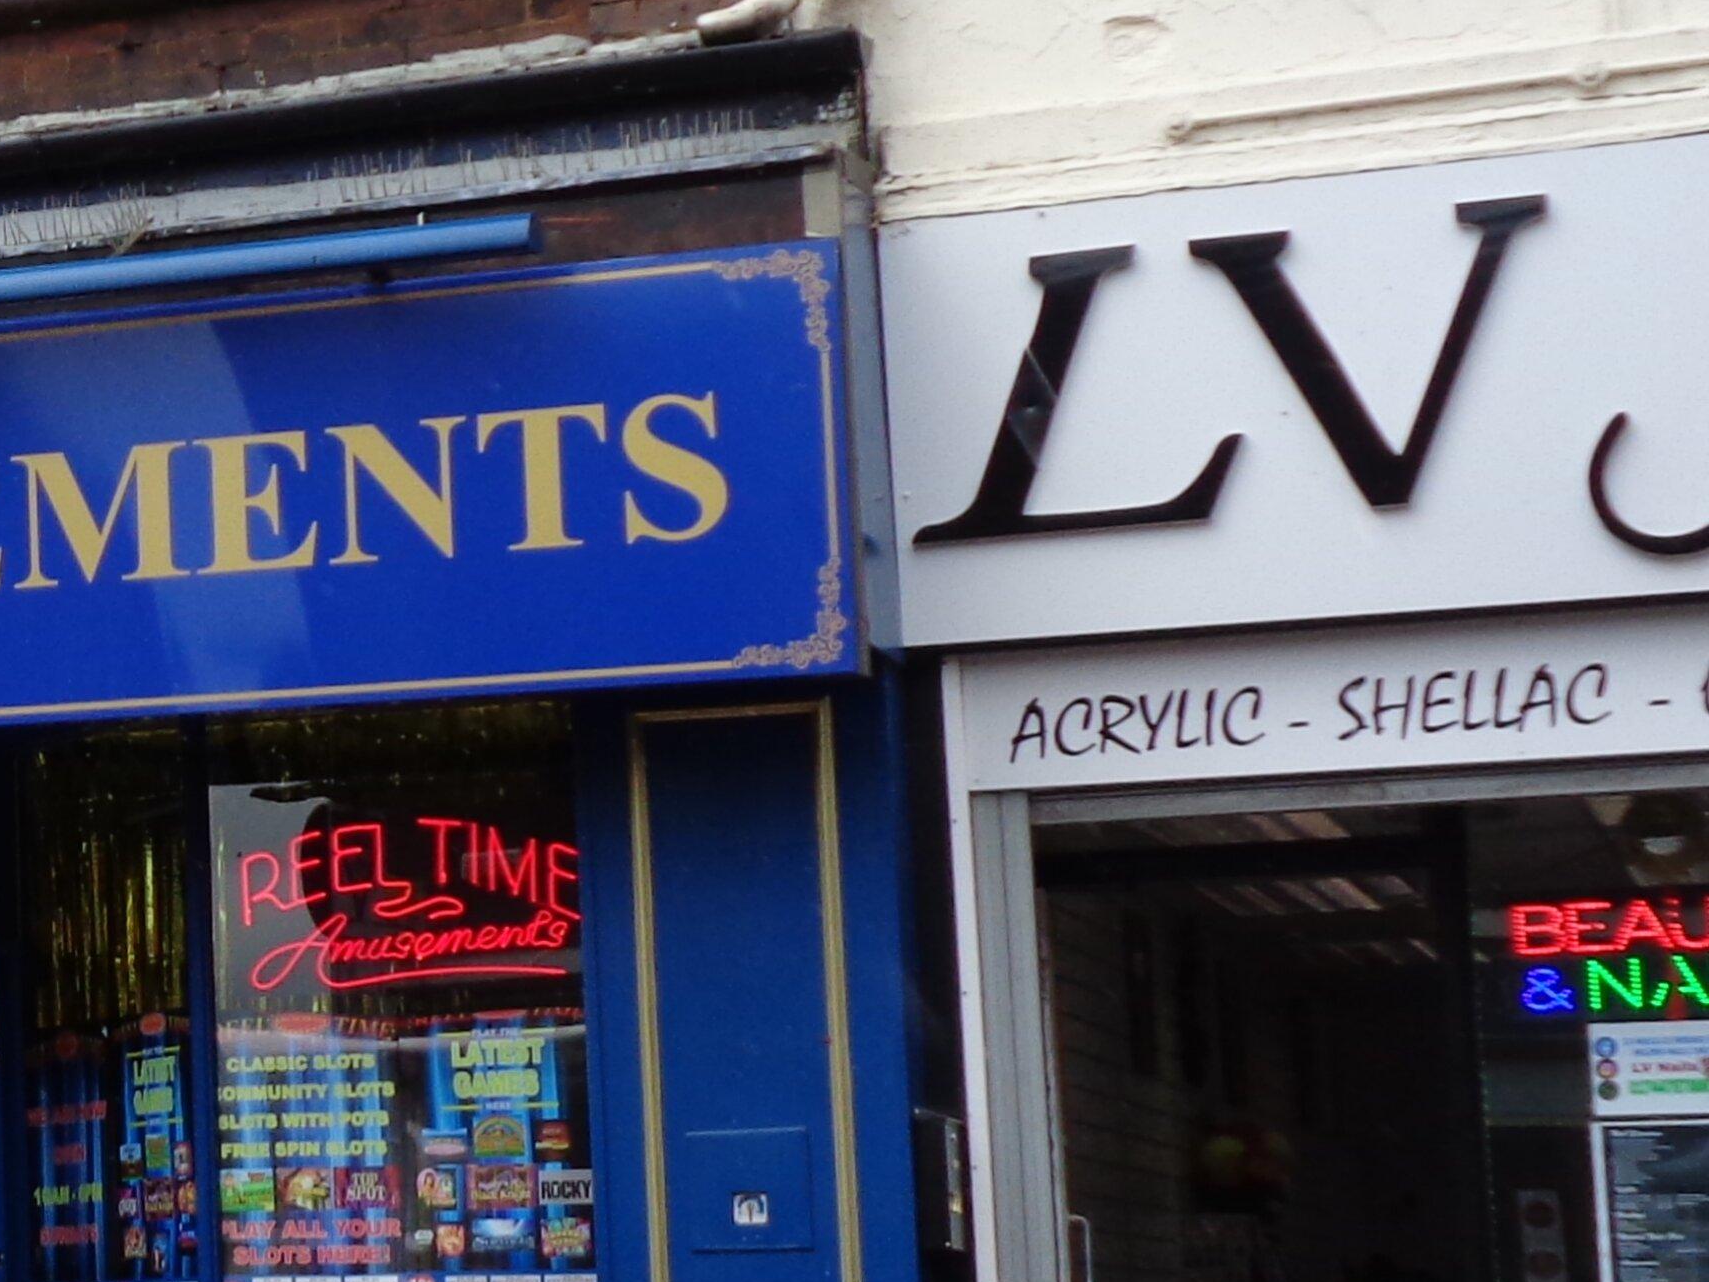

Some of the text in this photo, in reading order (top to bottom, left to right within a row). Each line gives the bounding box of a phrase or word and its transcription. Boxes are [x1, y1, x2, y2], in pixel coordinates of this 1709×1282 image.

[913, 193, 1548, 546] LV
[1010, 686, 1265, 764] ACRYLIC
[1337, 663, 1613, 745] SHELLAC
[239, 817, 582, 926] REEL TIME
[251, 911, 569, 991] Amusements
[226, 1052, 377, 1073] CLASSIC SLOTS
[450, 1036, 546, 1068] LATEST
[333, 1080, 396, 1099] SLOTS
[453, 1068, 541, 1100] GAMES
[219, 1112, 279, 1131] SLOTS
[338, 1109, 390, 1128] POTS
[221, 1139, 388, 1160] FREE SPIN SLOTS
[540, 1179, 592, 1201] ROCKY
[282, 1219, 329, 1239] ALL
[335, 1218, 403, 1238] YOUR
[232, 1244, 312, 1266] SLOTS
